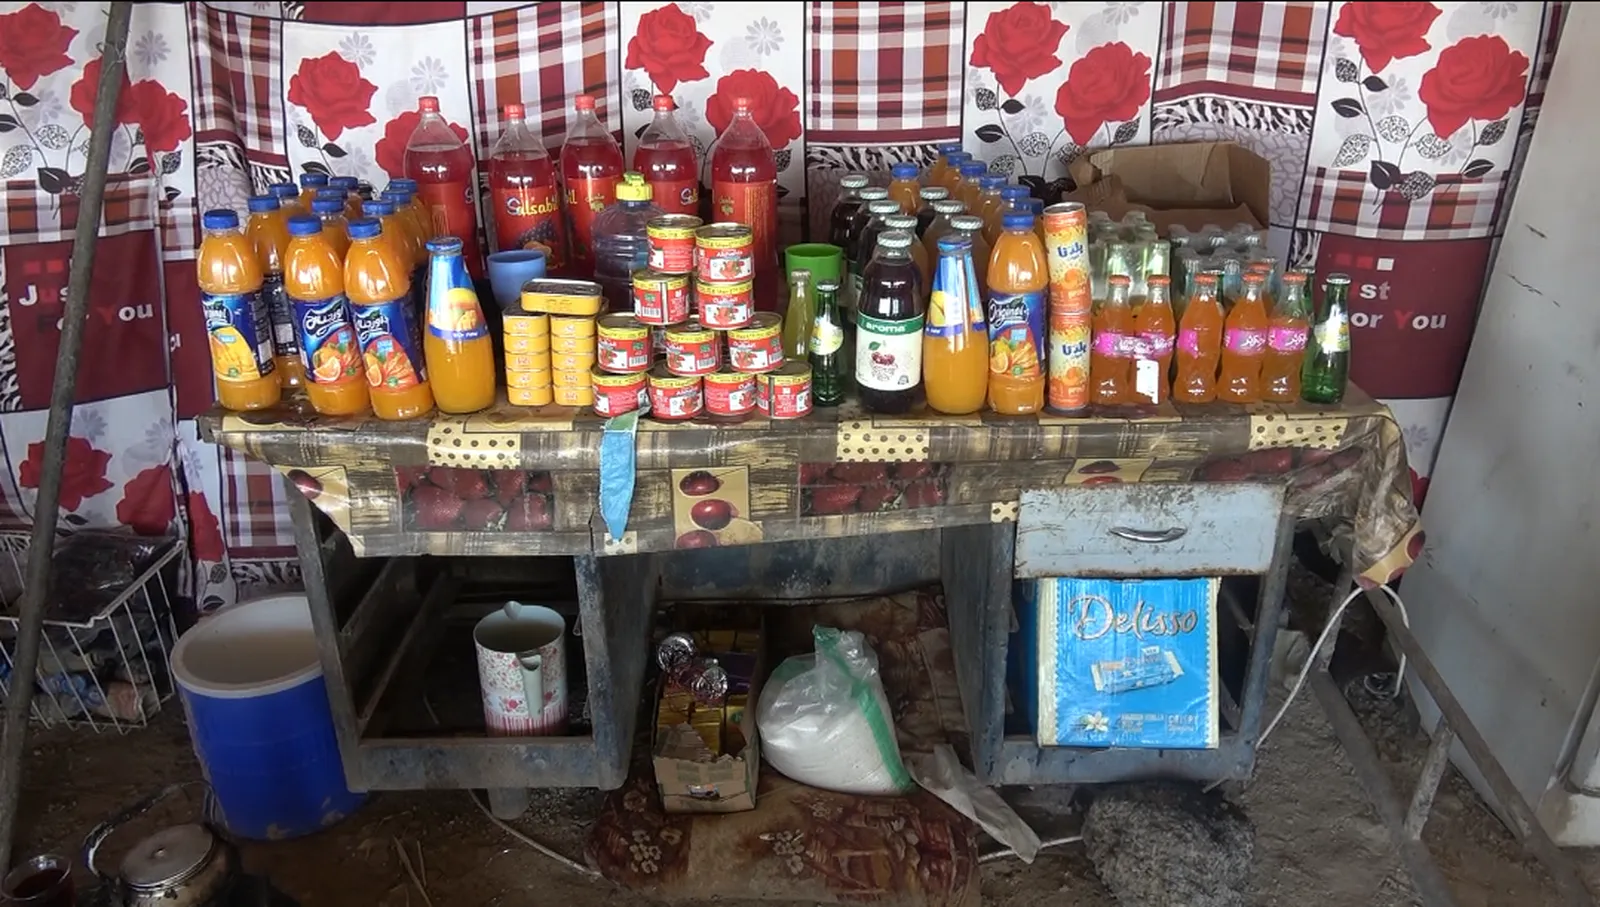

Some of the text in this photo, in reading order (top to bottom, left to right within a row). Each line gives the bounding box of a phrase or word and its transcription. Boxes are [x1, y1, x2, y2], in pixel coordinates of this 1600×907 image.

[97, 303, 153, 326] You
[1350, 309, 1447, 330] or You
[865, 323, 907, 333] aroma
[1068, 595, 1199, 641] Delisso
